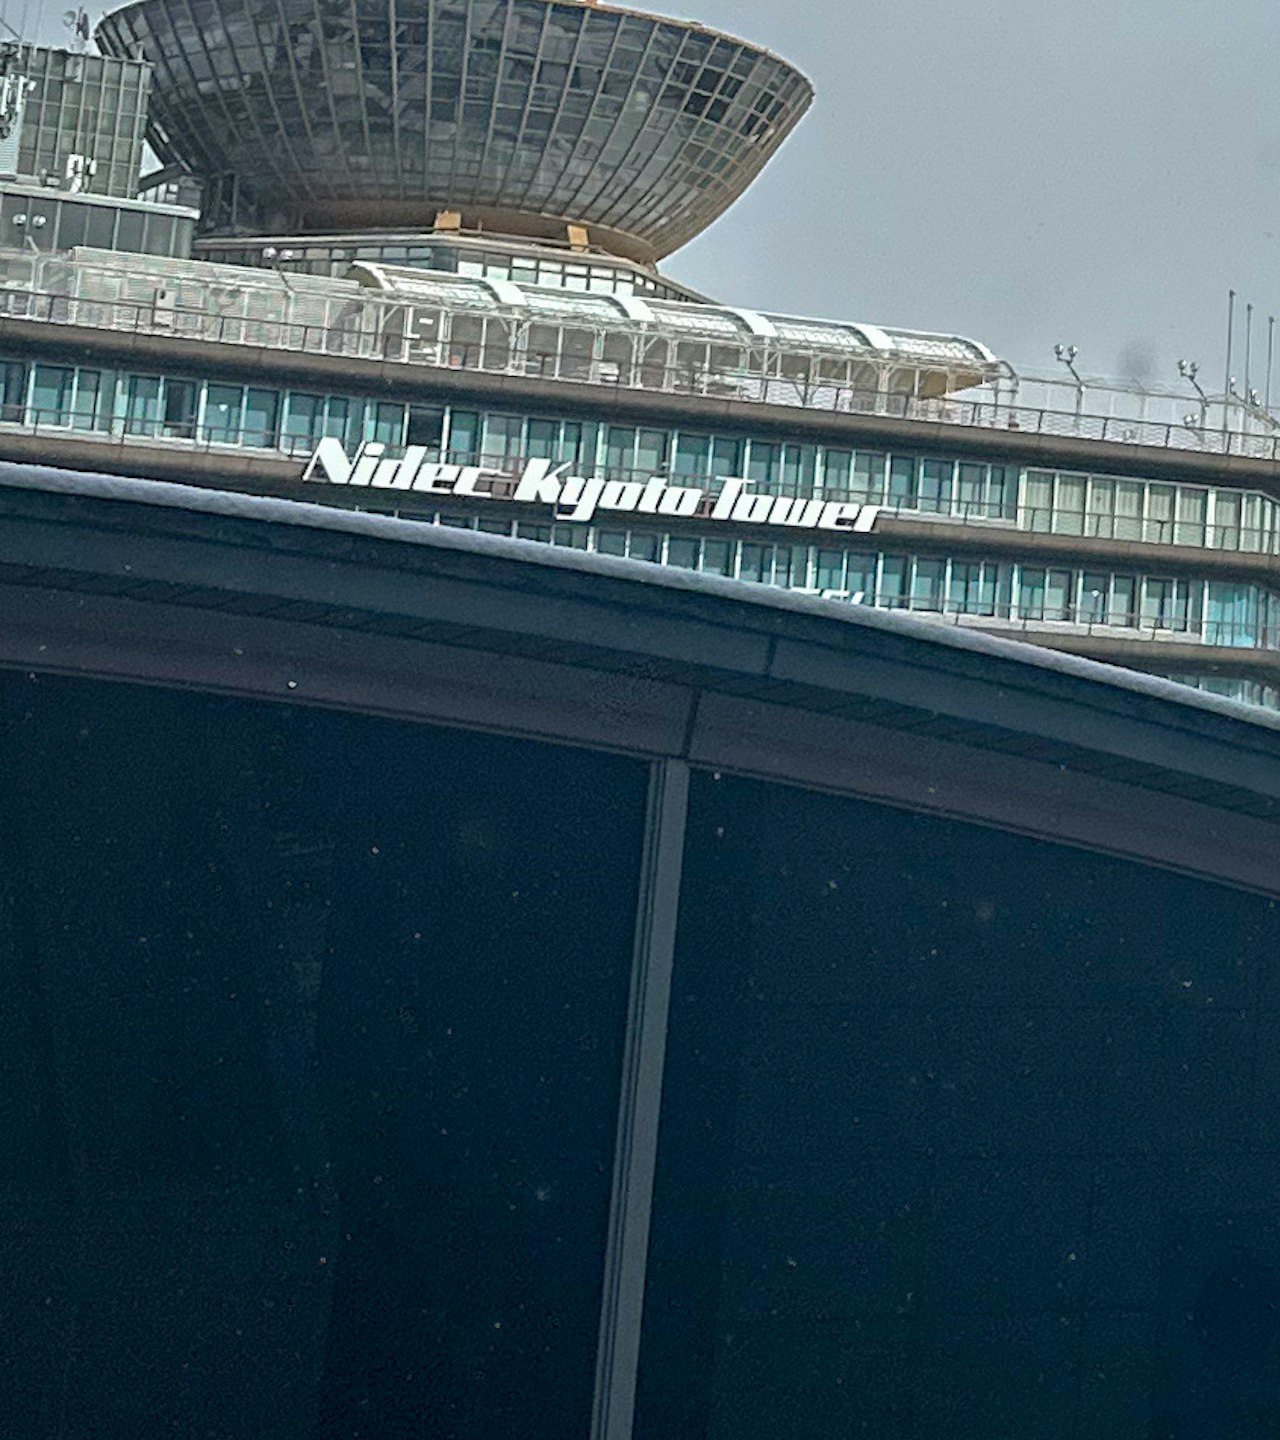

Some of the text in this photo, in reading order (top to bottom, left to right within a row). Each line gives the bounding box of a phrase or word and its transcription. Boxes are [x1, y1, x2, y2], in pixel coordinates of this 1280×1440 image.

[302, 436, 883, 534] Nidec Kyoto Tower
